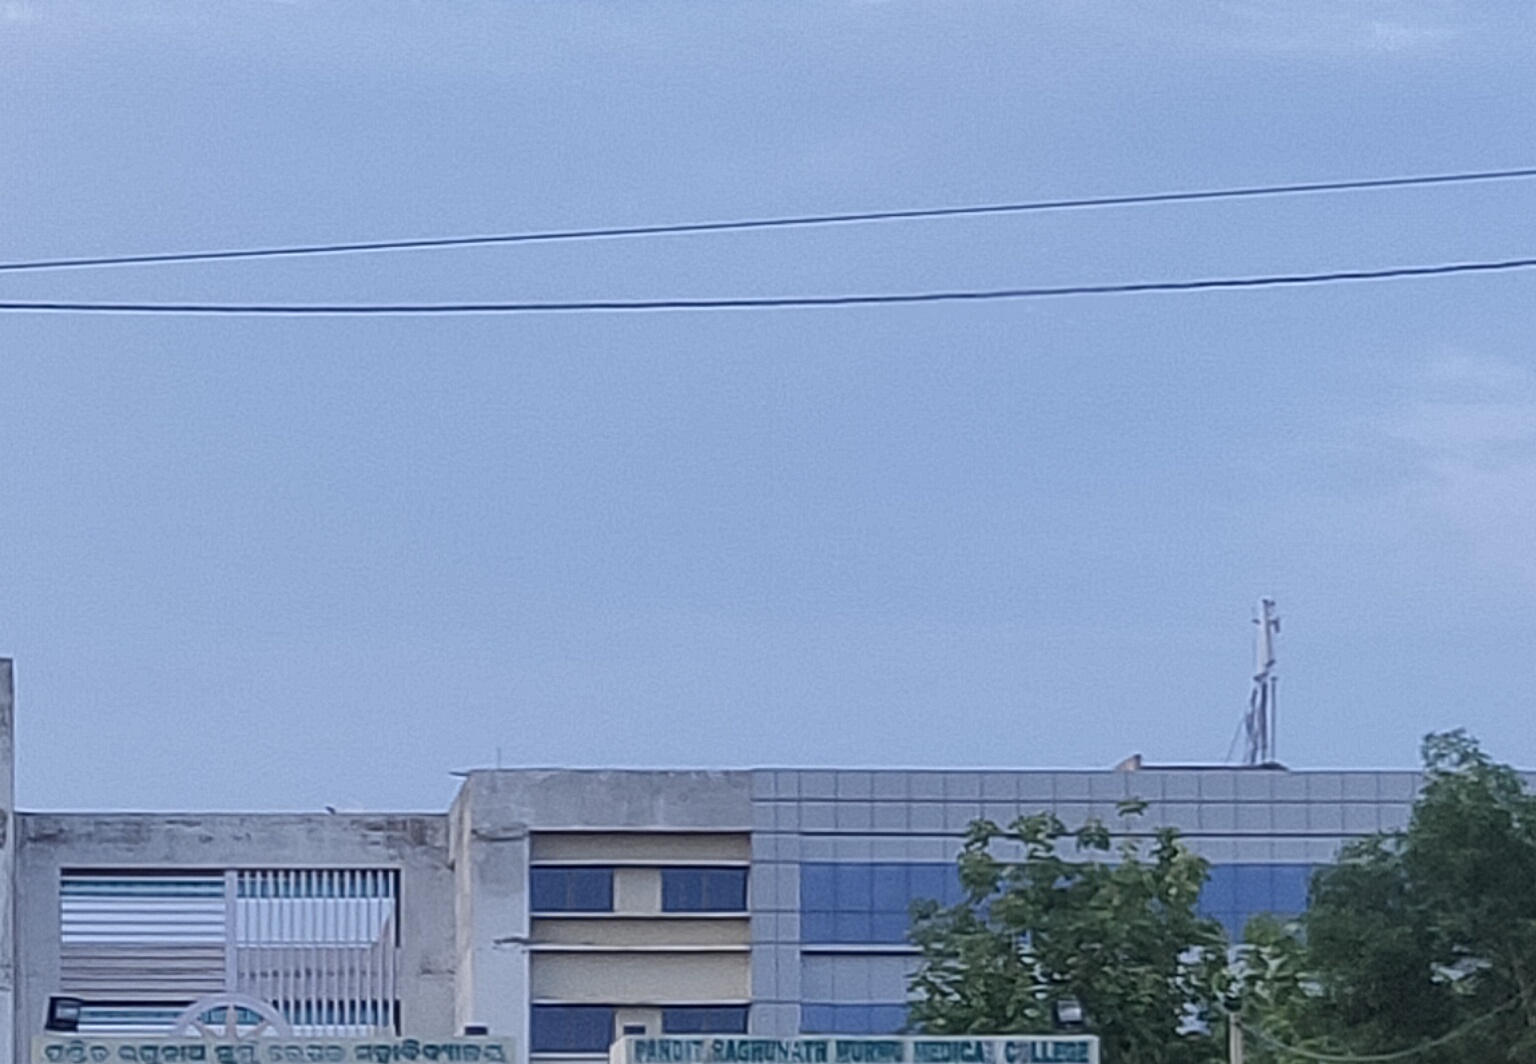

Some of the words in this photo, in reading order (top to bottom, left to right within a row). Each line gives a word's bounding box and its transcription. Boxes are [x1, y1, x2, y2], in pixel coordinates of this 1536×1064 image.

[634, 1039, 702, 1063] PANDIT
[711, 1039, 827, 1063] RAGHUNATH
[836, 1039, 904, 1063] MURMU
[1004, 1040, 1089, 1064] CLLEGE
